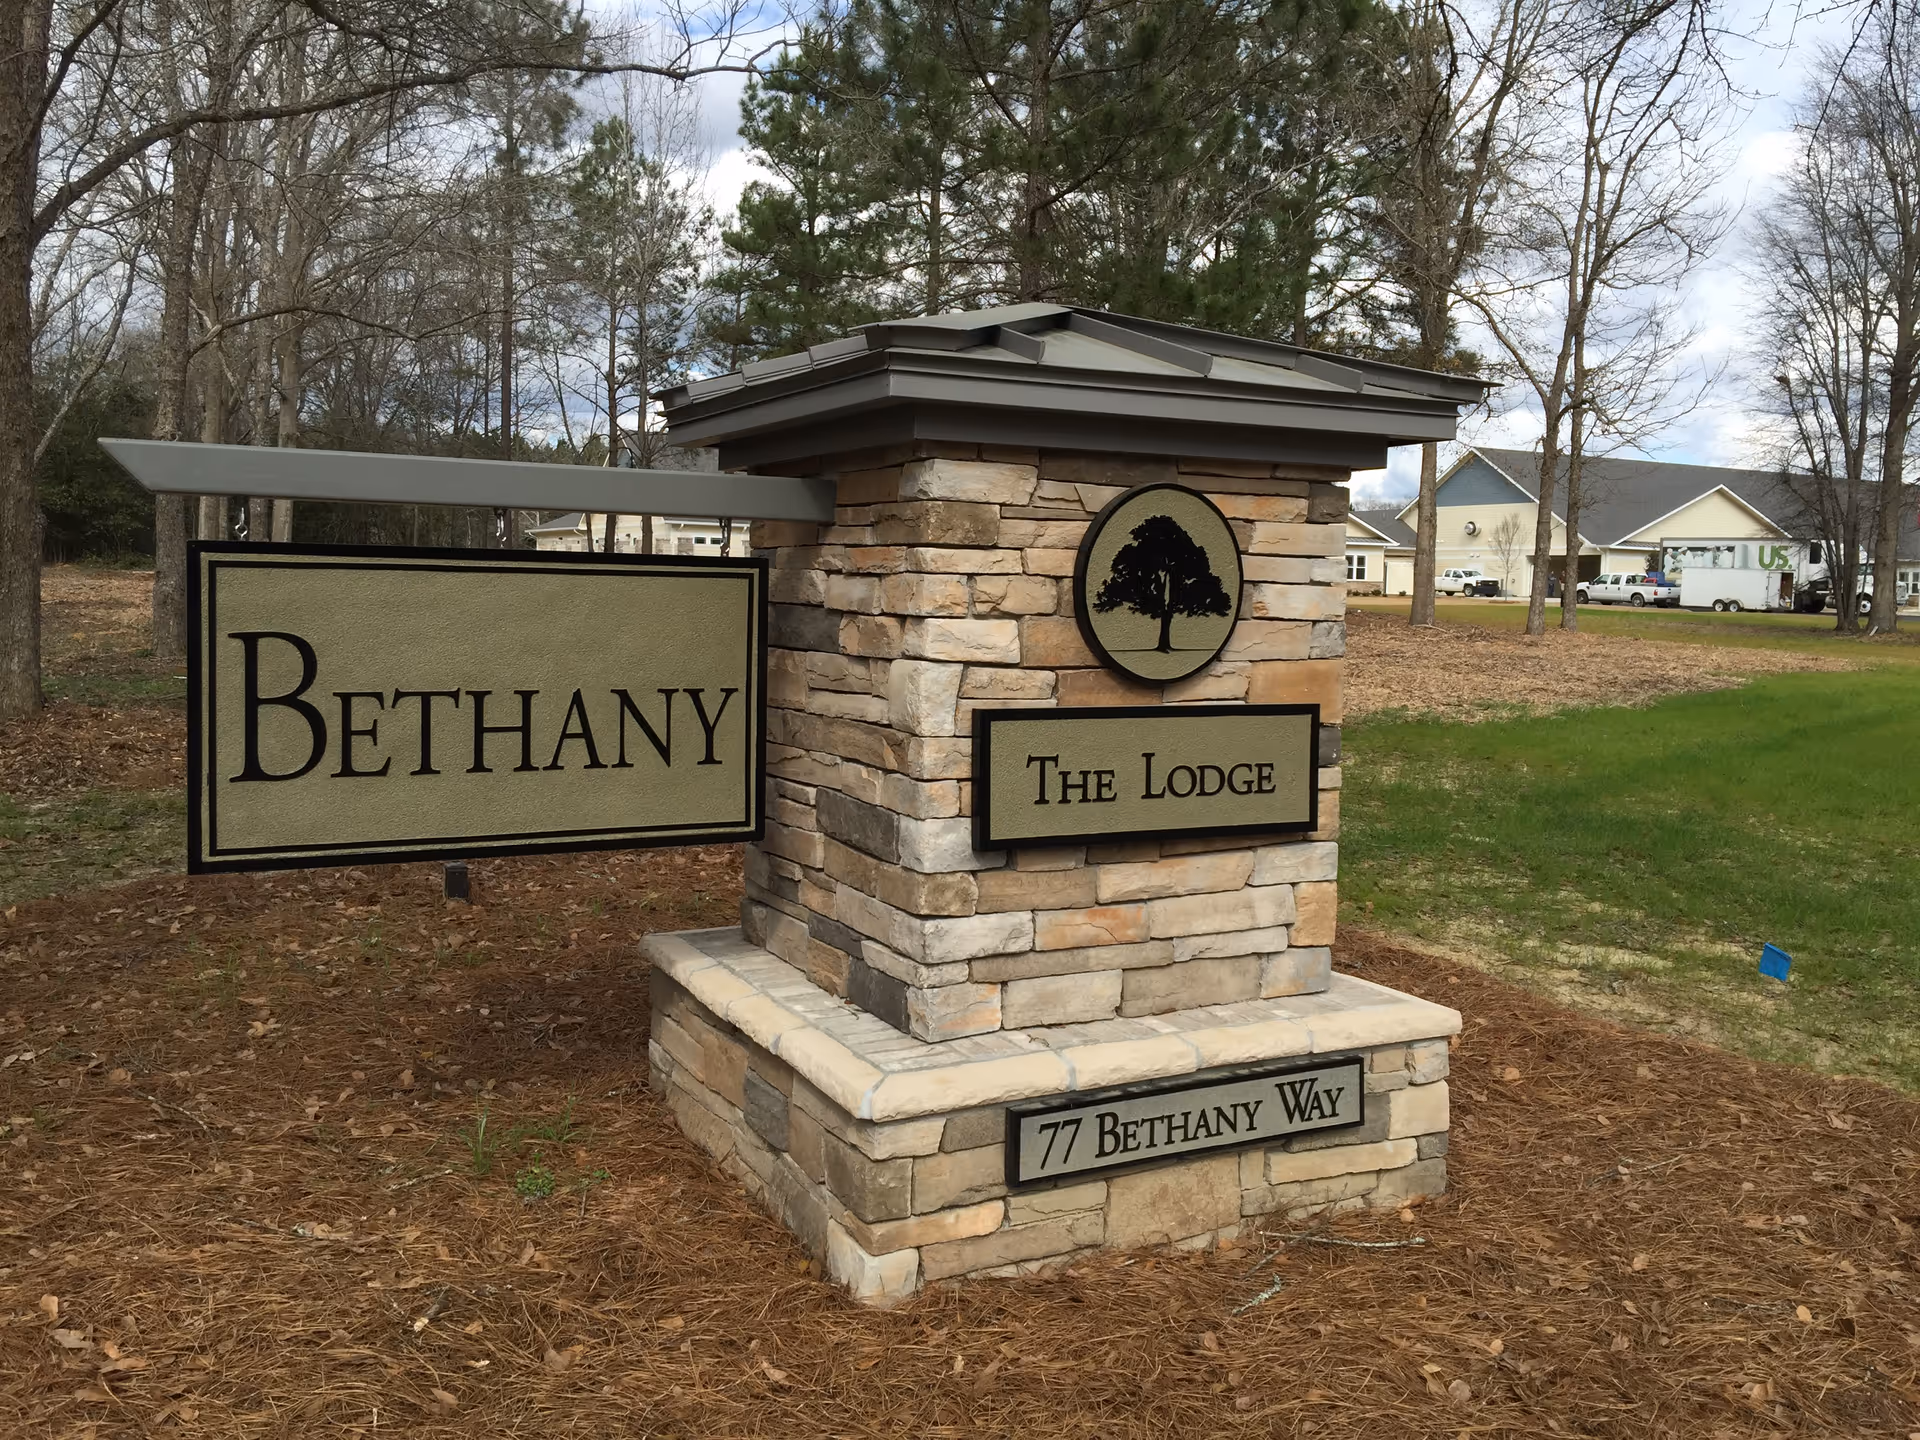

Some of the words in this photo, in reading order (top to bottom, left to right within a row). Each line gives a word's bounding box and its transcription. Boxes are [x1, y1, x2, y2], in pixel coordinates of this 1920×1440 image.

[227, 630, 740, 784] BETHANY
[1026, 753, 1118, 806] THE
[1141, 752, 1277, 800] LODGE
[1038, 1117, 1084, 1171] 77
[1094, 1099, 1264, 1159] BETHANY
[1275, 1076, 1345, 1125] WAY
